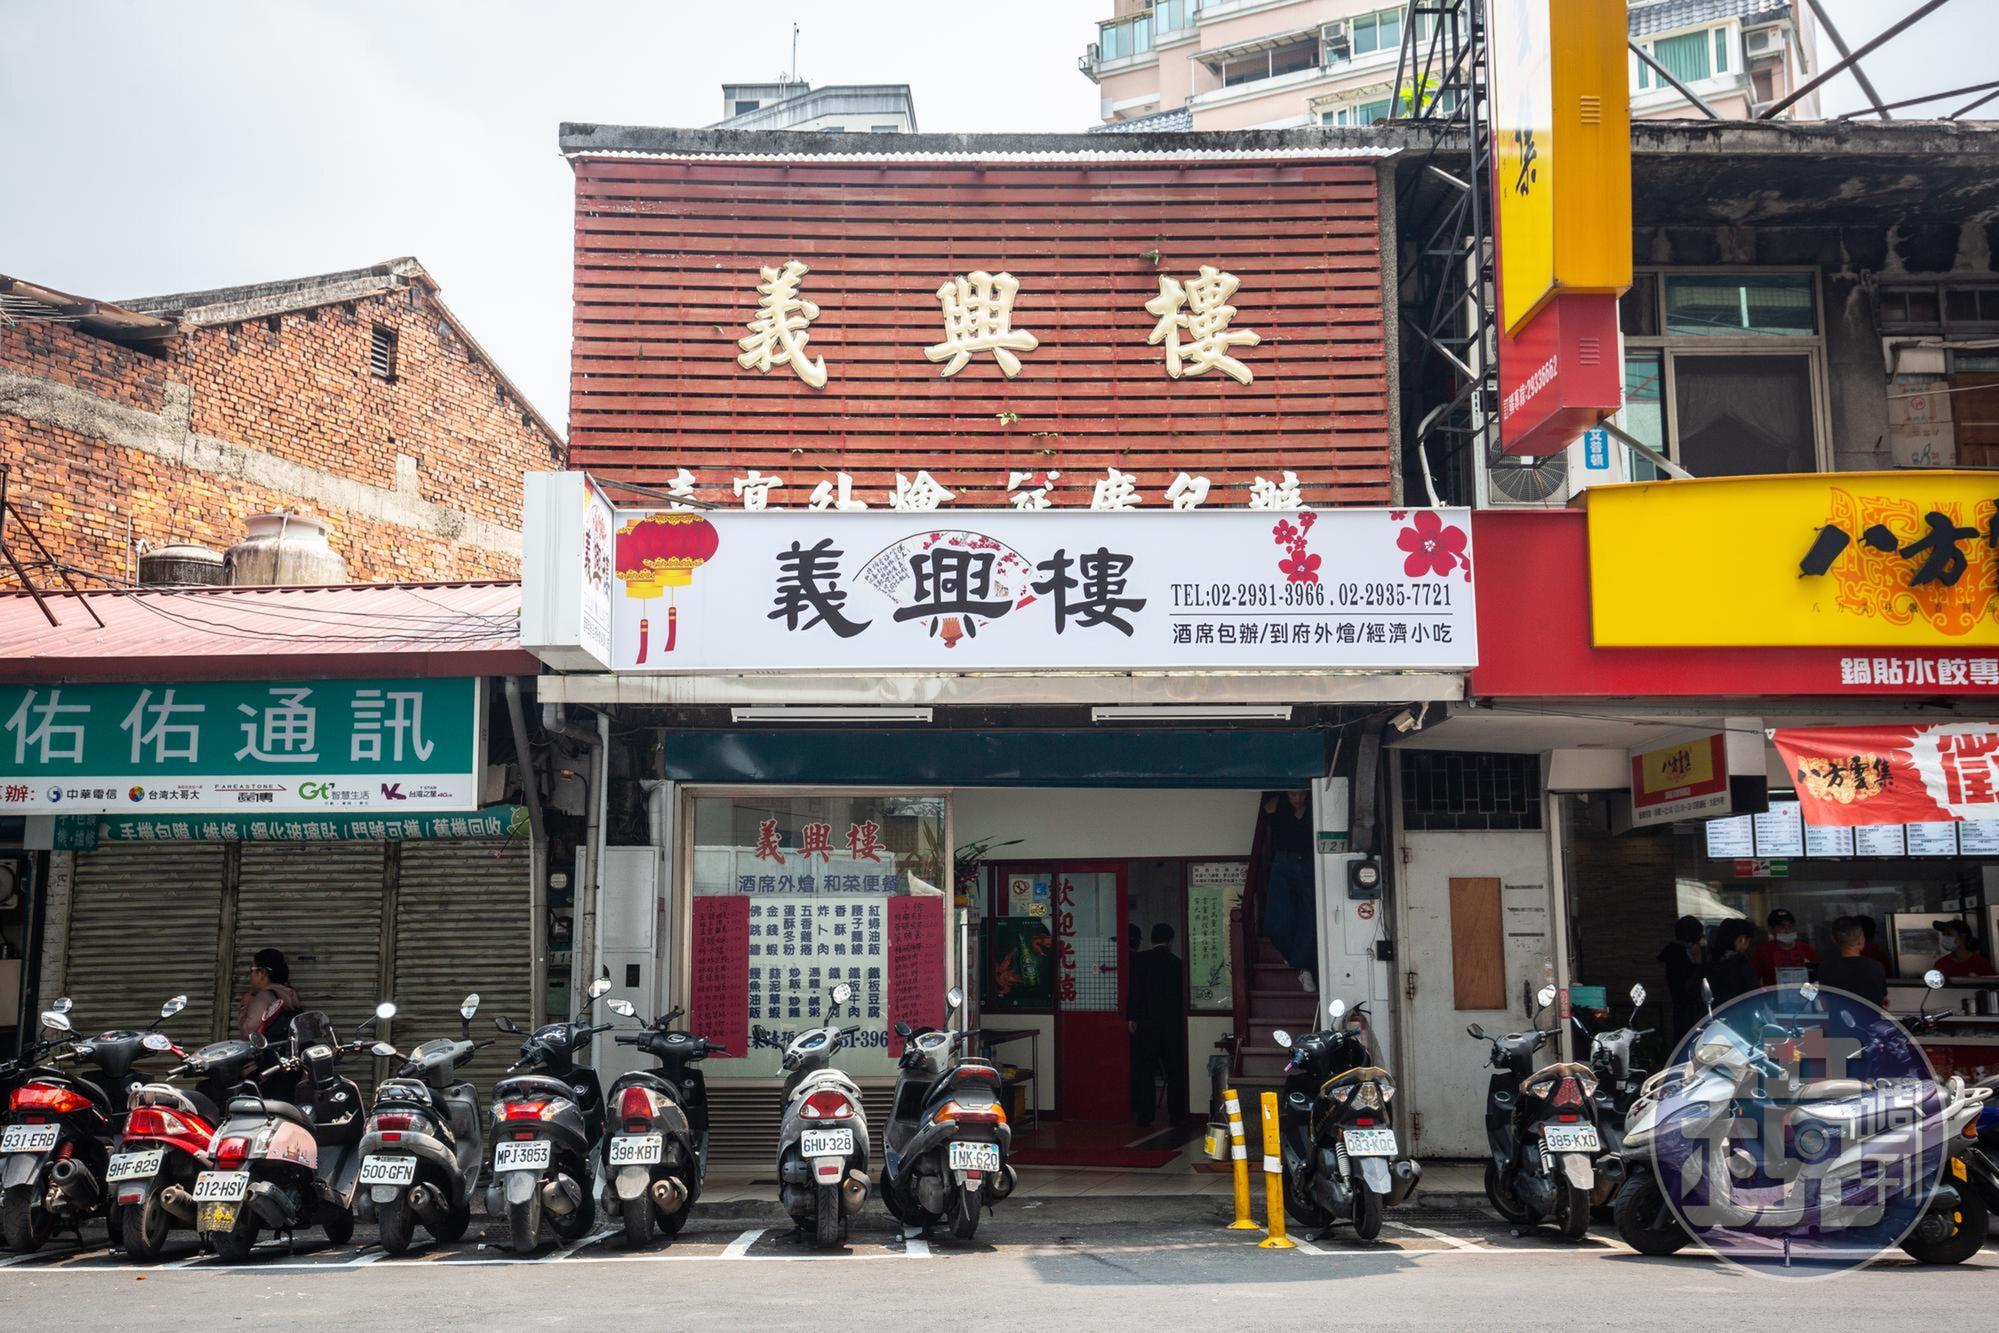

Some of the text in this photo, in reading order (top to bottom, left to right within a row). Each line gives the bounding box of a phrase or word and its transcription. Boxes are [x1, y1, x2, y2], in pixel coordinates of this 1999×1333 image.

[738, 261, 1262, 390] 義興樓
[1798, 496, 1999, 592] 八方
[768, 538, 1147, 638] 義興樓
[4, 687, 435, 764] 佑佑通訊
[1797, 755, 1895, 790] 八方雲集
[66, 788, 118, 800] 中華電信
[331, 790, 370, 801] 智慧生活
[755, 818, 886, 865] 義興樓
[1321, 840, 1345, 851] 121
[738, 874, 899, 893] 酒席外燴 和菜便餐
